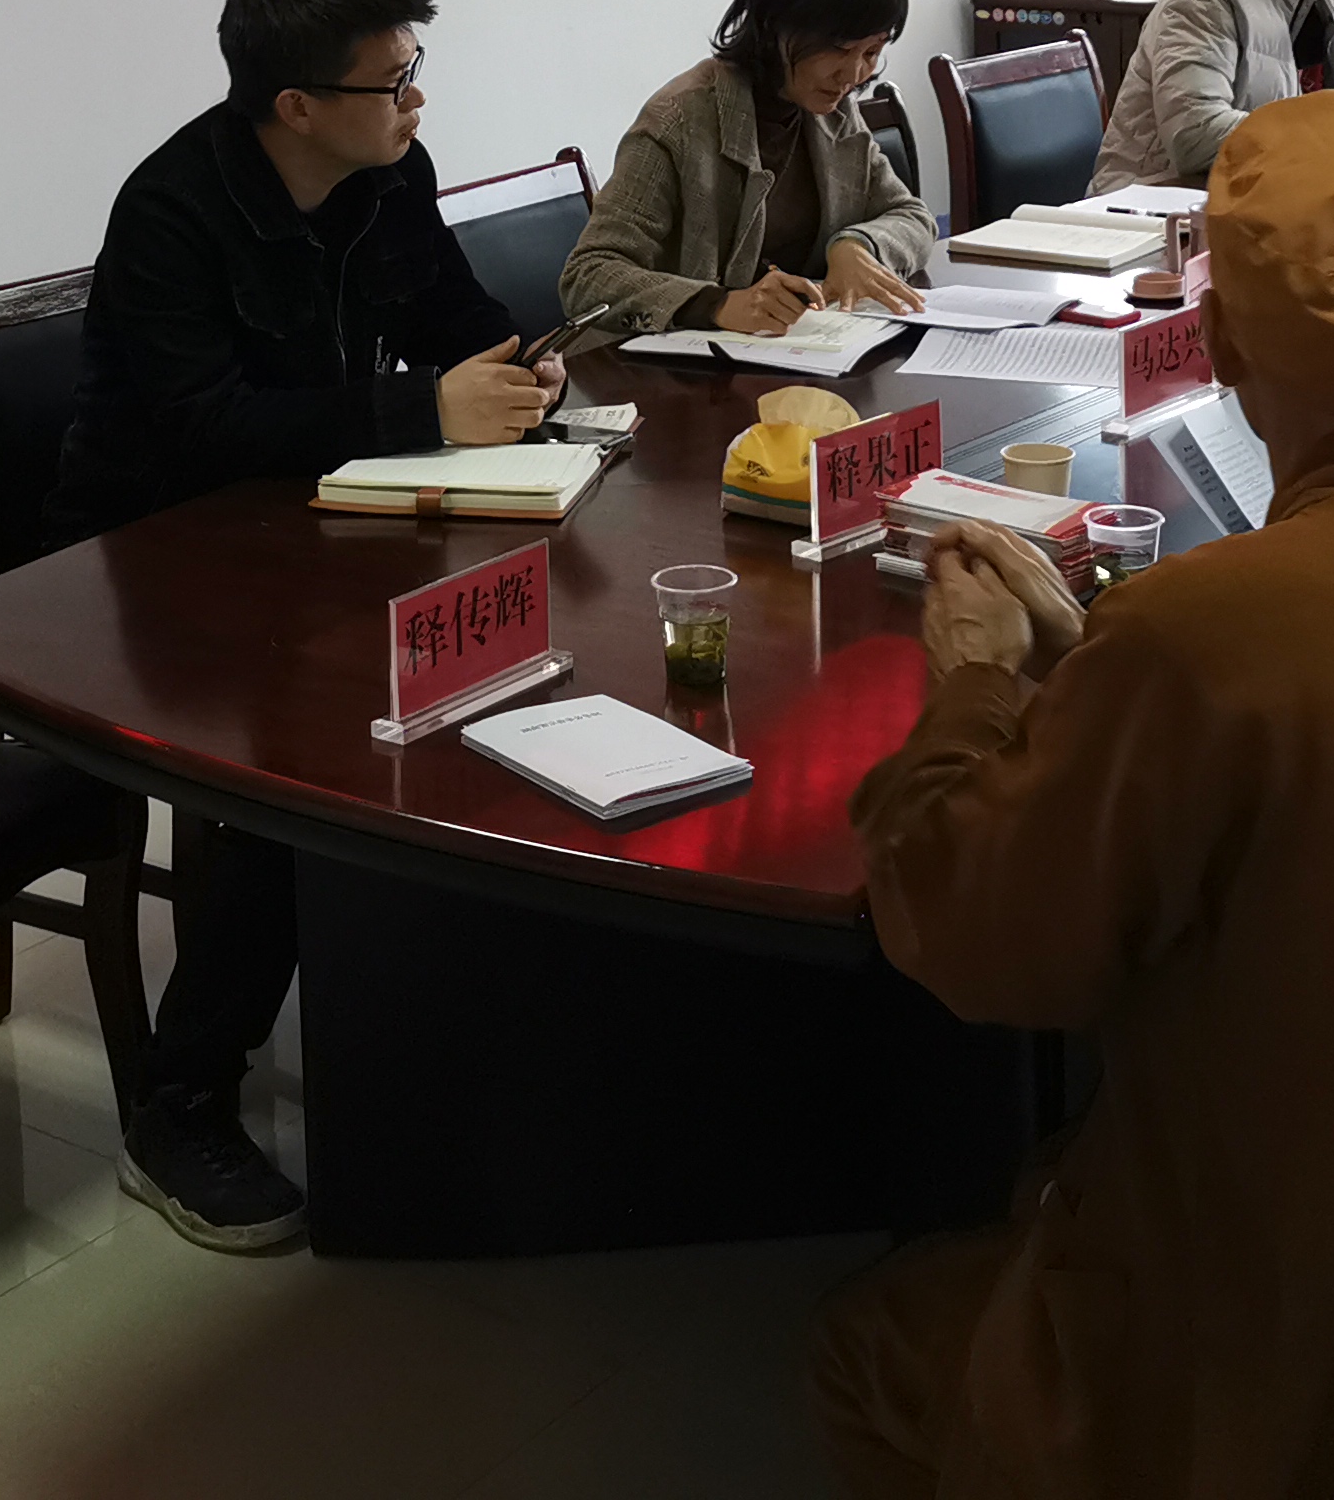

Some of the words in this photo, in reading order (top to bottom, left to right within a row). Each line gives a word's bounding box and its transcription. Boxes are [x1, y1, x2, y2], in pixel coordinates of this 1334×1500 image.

[826, 419, 934, 503] 释果正
[404, 565, 536, 676] 释传辉
